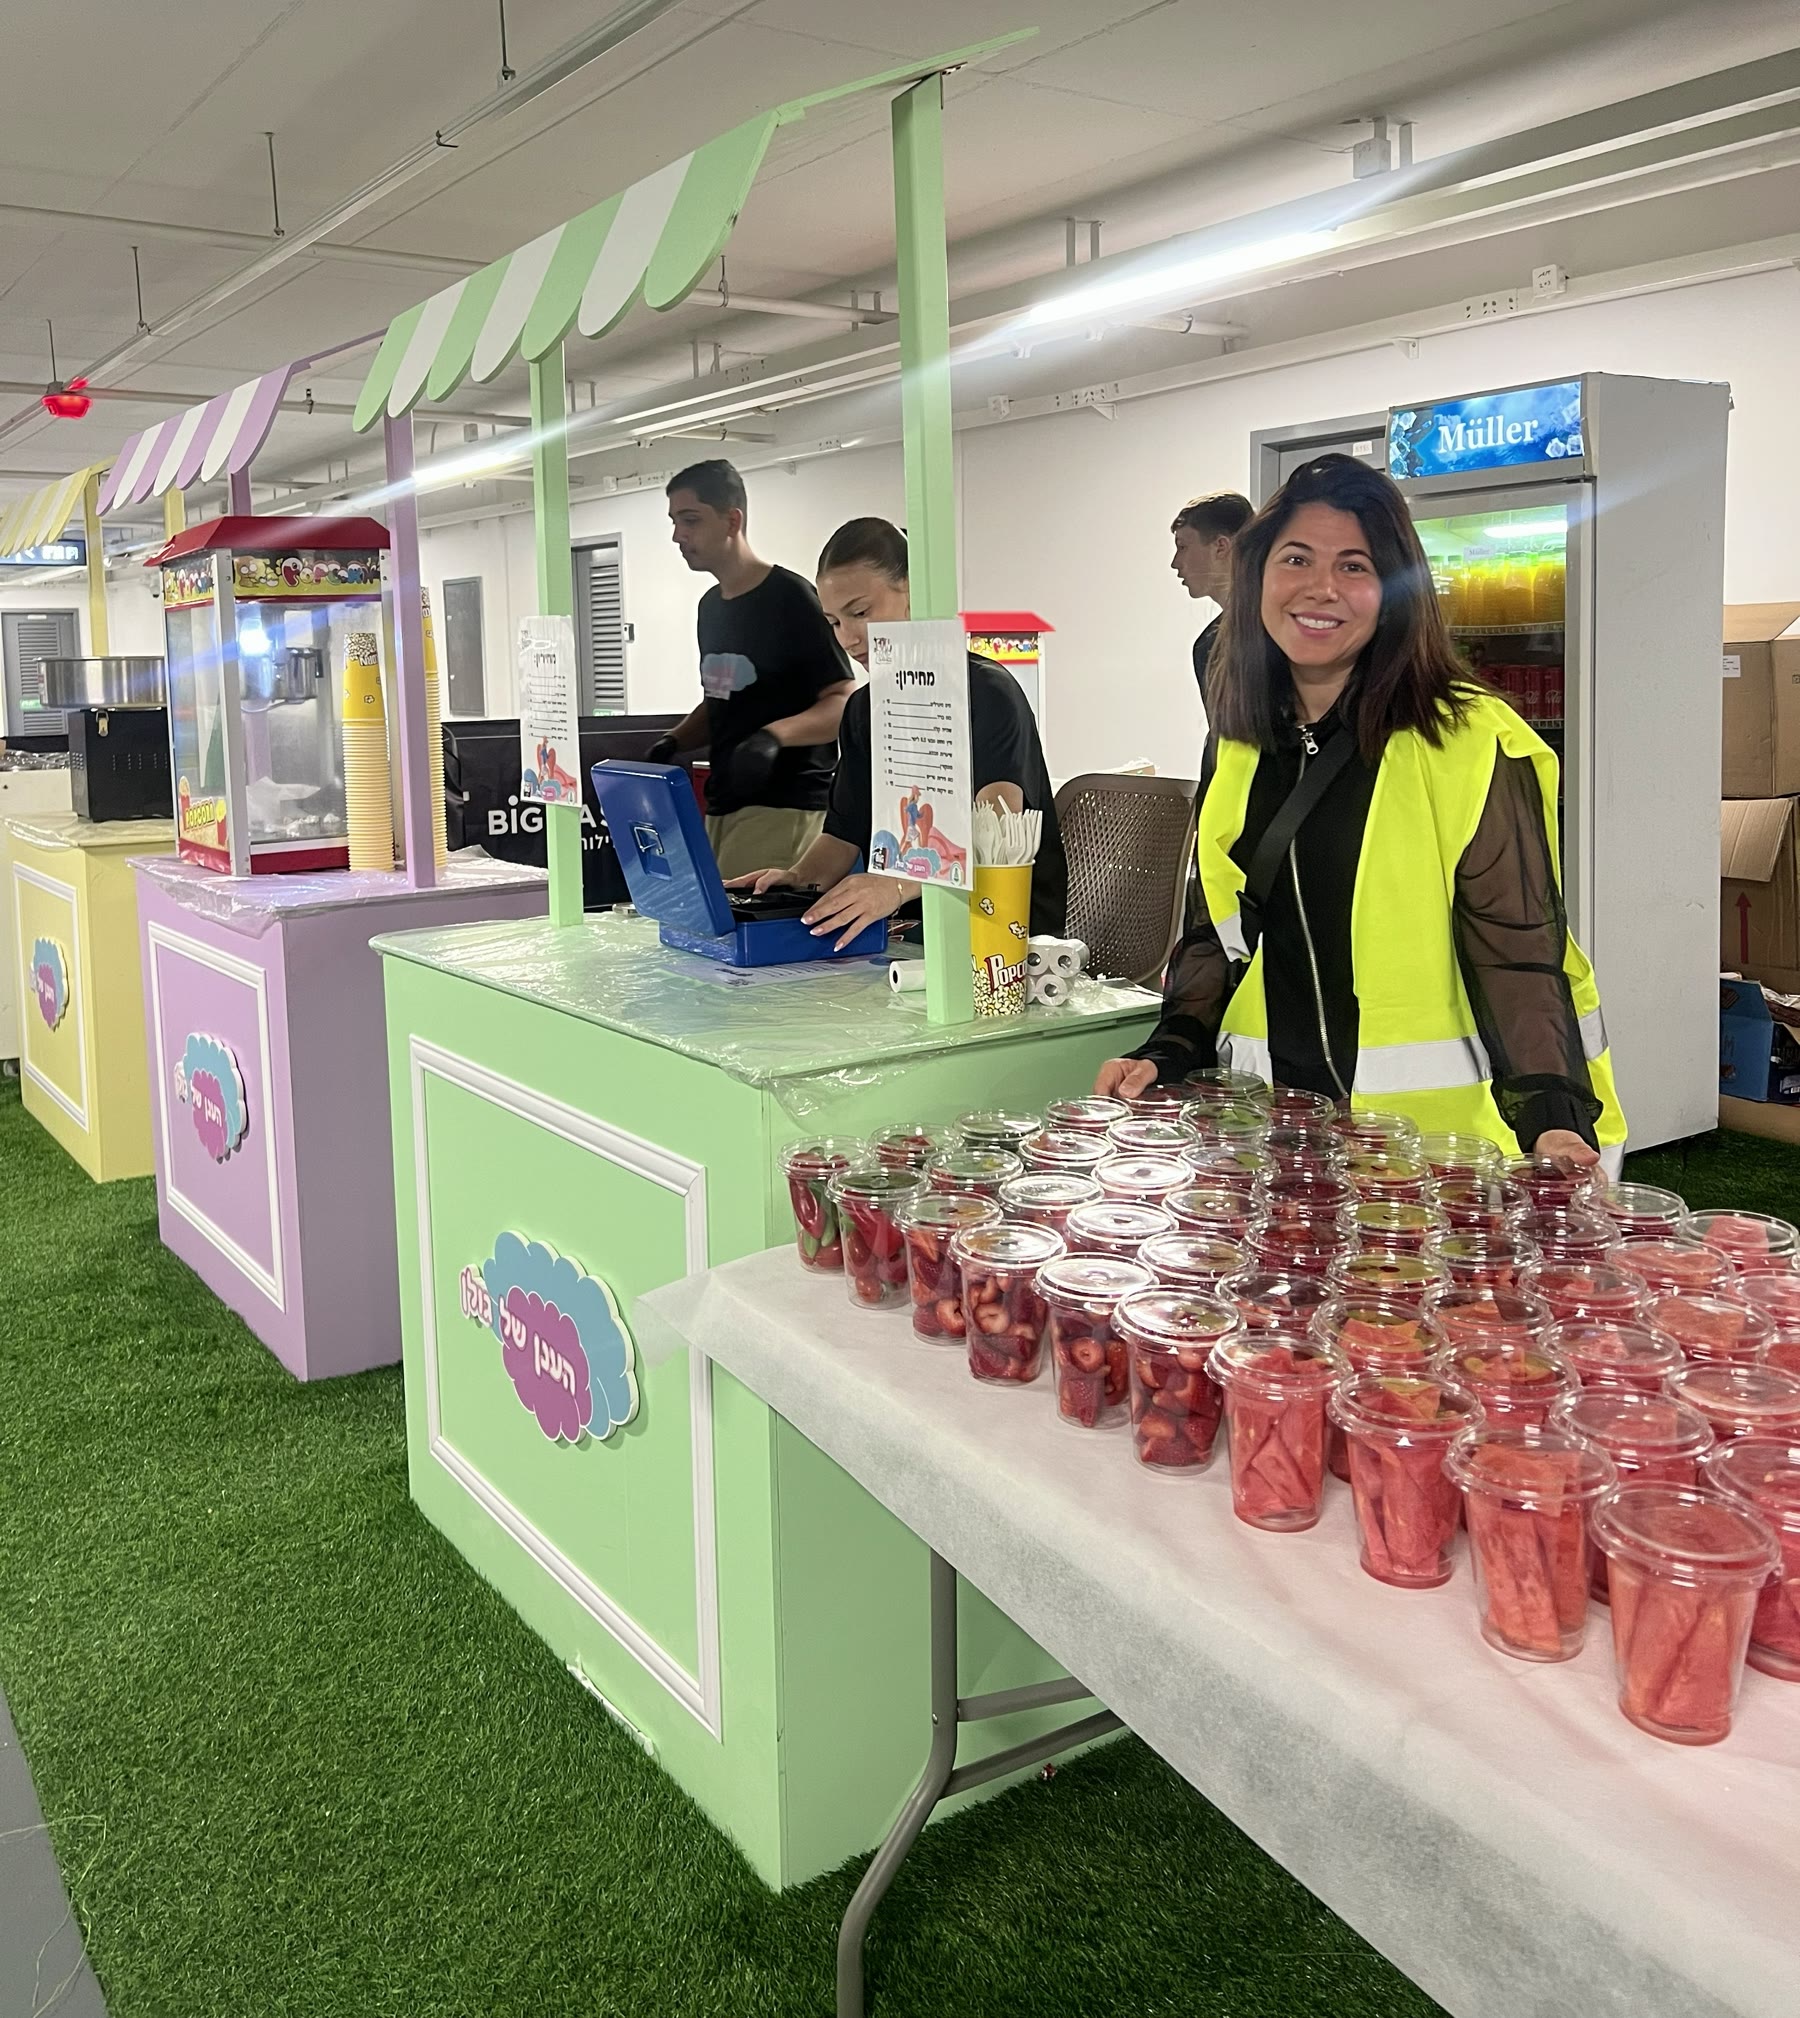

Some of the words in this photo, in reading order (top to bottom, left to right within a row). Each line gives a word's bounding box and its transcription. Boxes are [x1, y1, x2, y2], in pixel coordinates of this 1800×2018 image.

[1438, 415, 1539, 454] Müller
[896, 670, 935, 690] מחירון:
[460, 1267, 494, 1326] גולן
[498, 1296, 527, 1348] של
[533, 1333, 576, 1396] הענן
